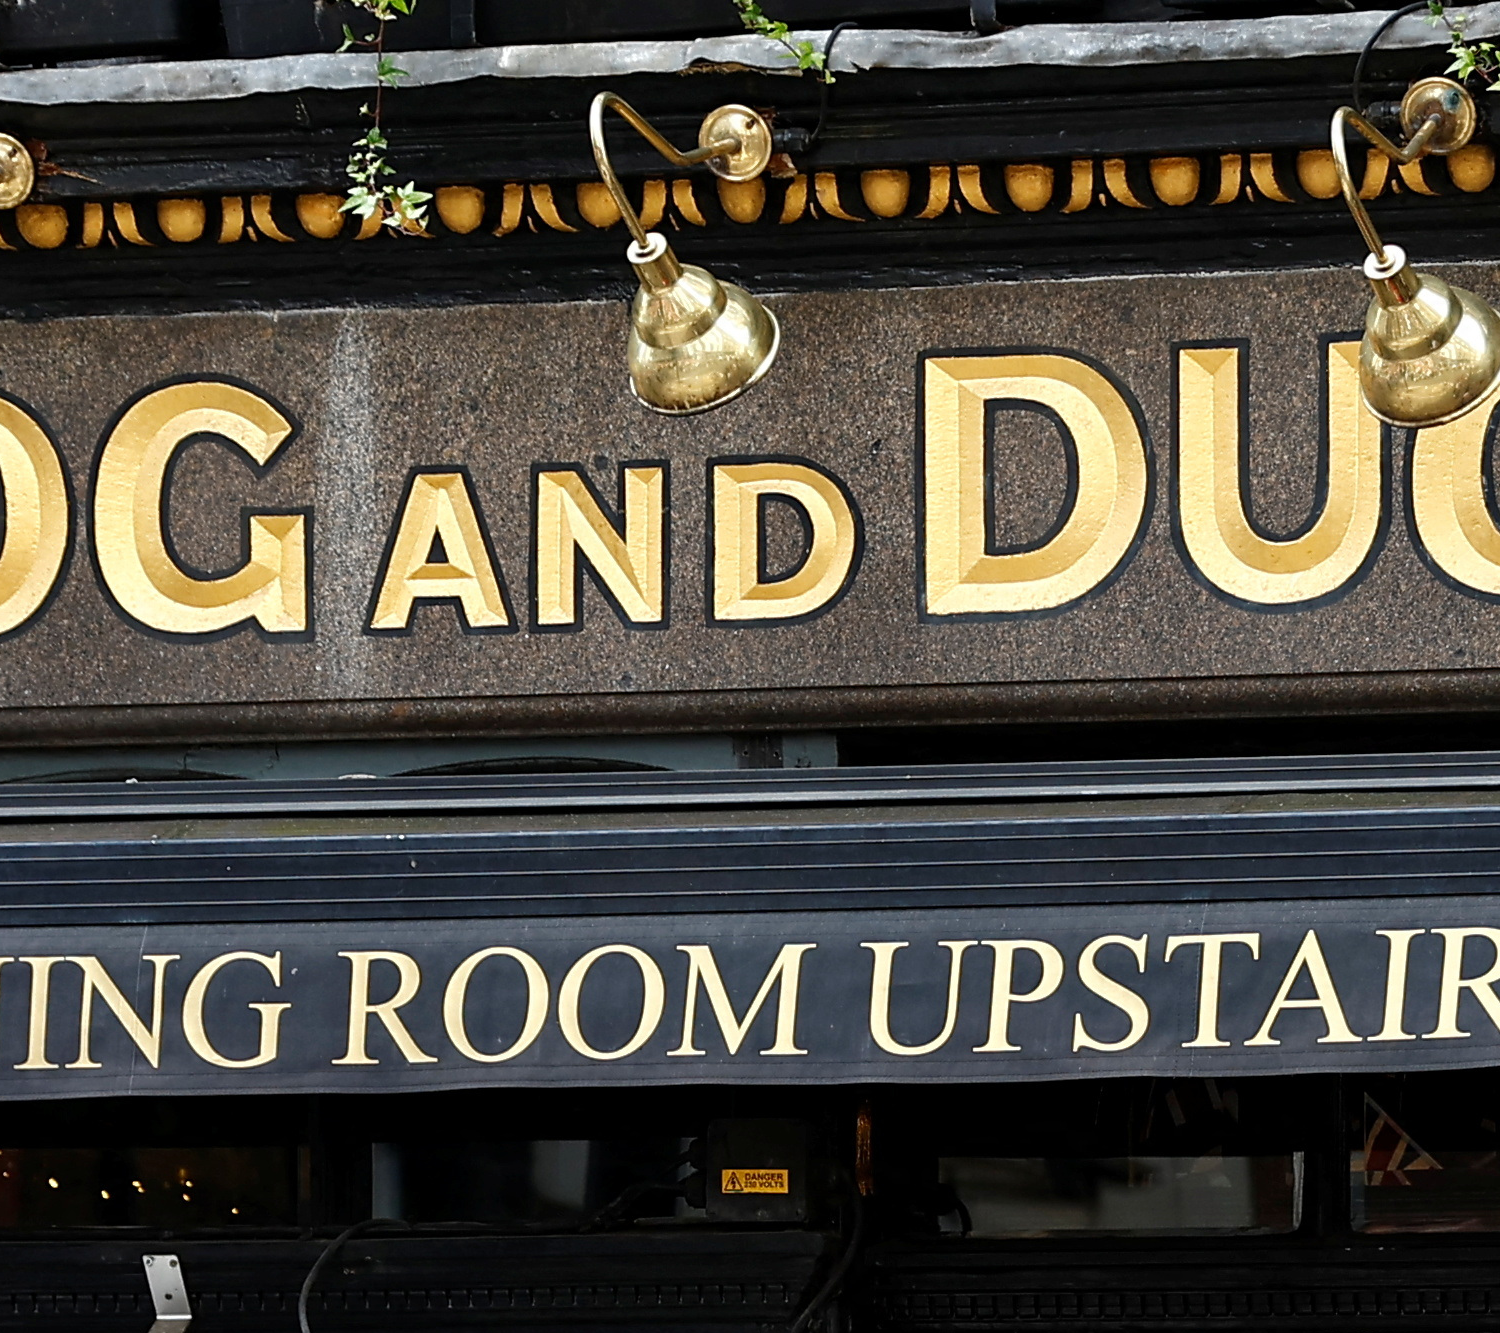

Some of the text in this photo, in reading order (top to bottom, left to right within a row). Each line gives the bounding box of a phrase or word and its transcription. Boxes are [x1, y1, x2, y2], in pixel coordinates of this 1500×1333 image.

[368, 459, 859, 631] AND
[330, 941, 817, 1067] ROOM
[744, 1172, 784, 1181] DANGER
